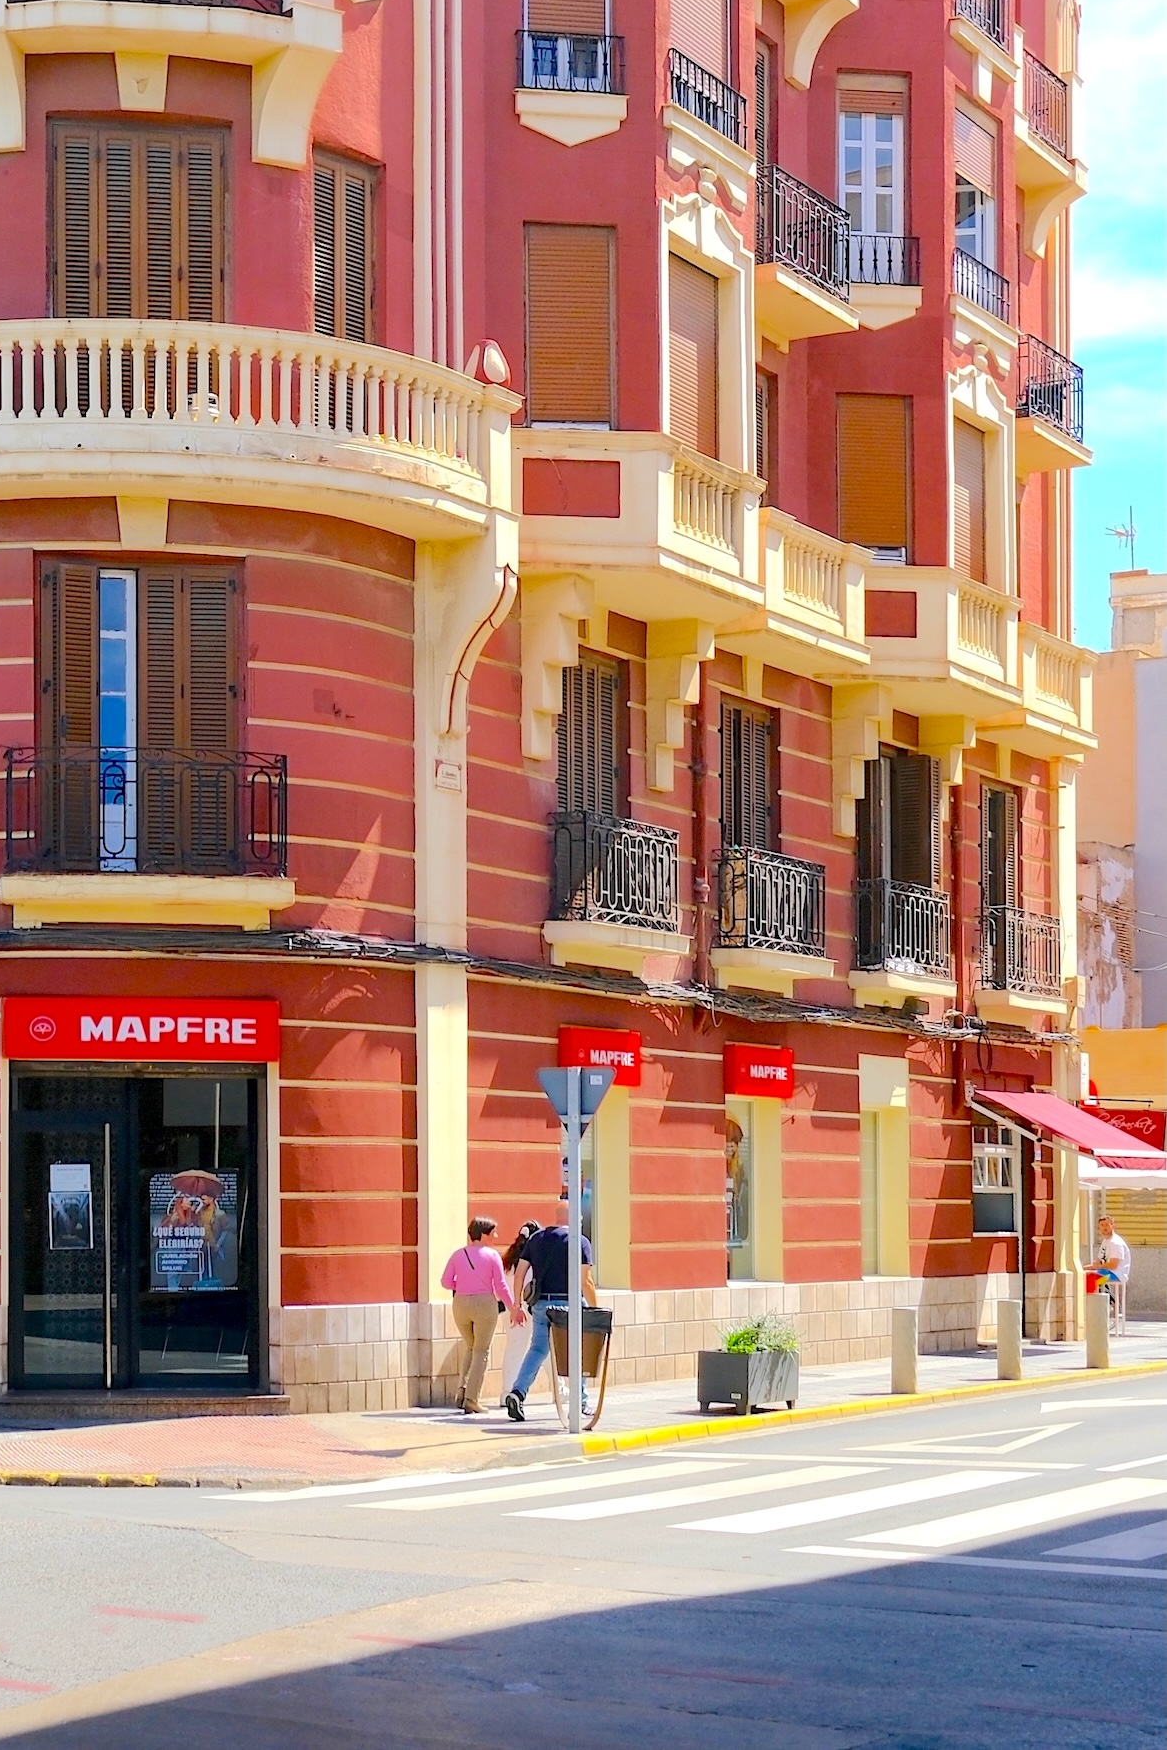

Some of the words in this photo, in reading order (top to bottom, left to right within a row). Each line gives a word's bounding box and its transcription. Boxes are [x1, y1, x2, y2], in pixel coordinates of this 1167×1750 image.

[80, 1016, 257, 1044] MAPFRE
[589, 1048, 635, 1067] MAPFRE
[749, 1064, 788, 1080] MAPFRE
[152, 1225, 173, 1238] ¿QUÉ
[174, 1226, 206, 1238] SEGURO
[159, 1237, 204, 1249] ELEGIRÍAS?
